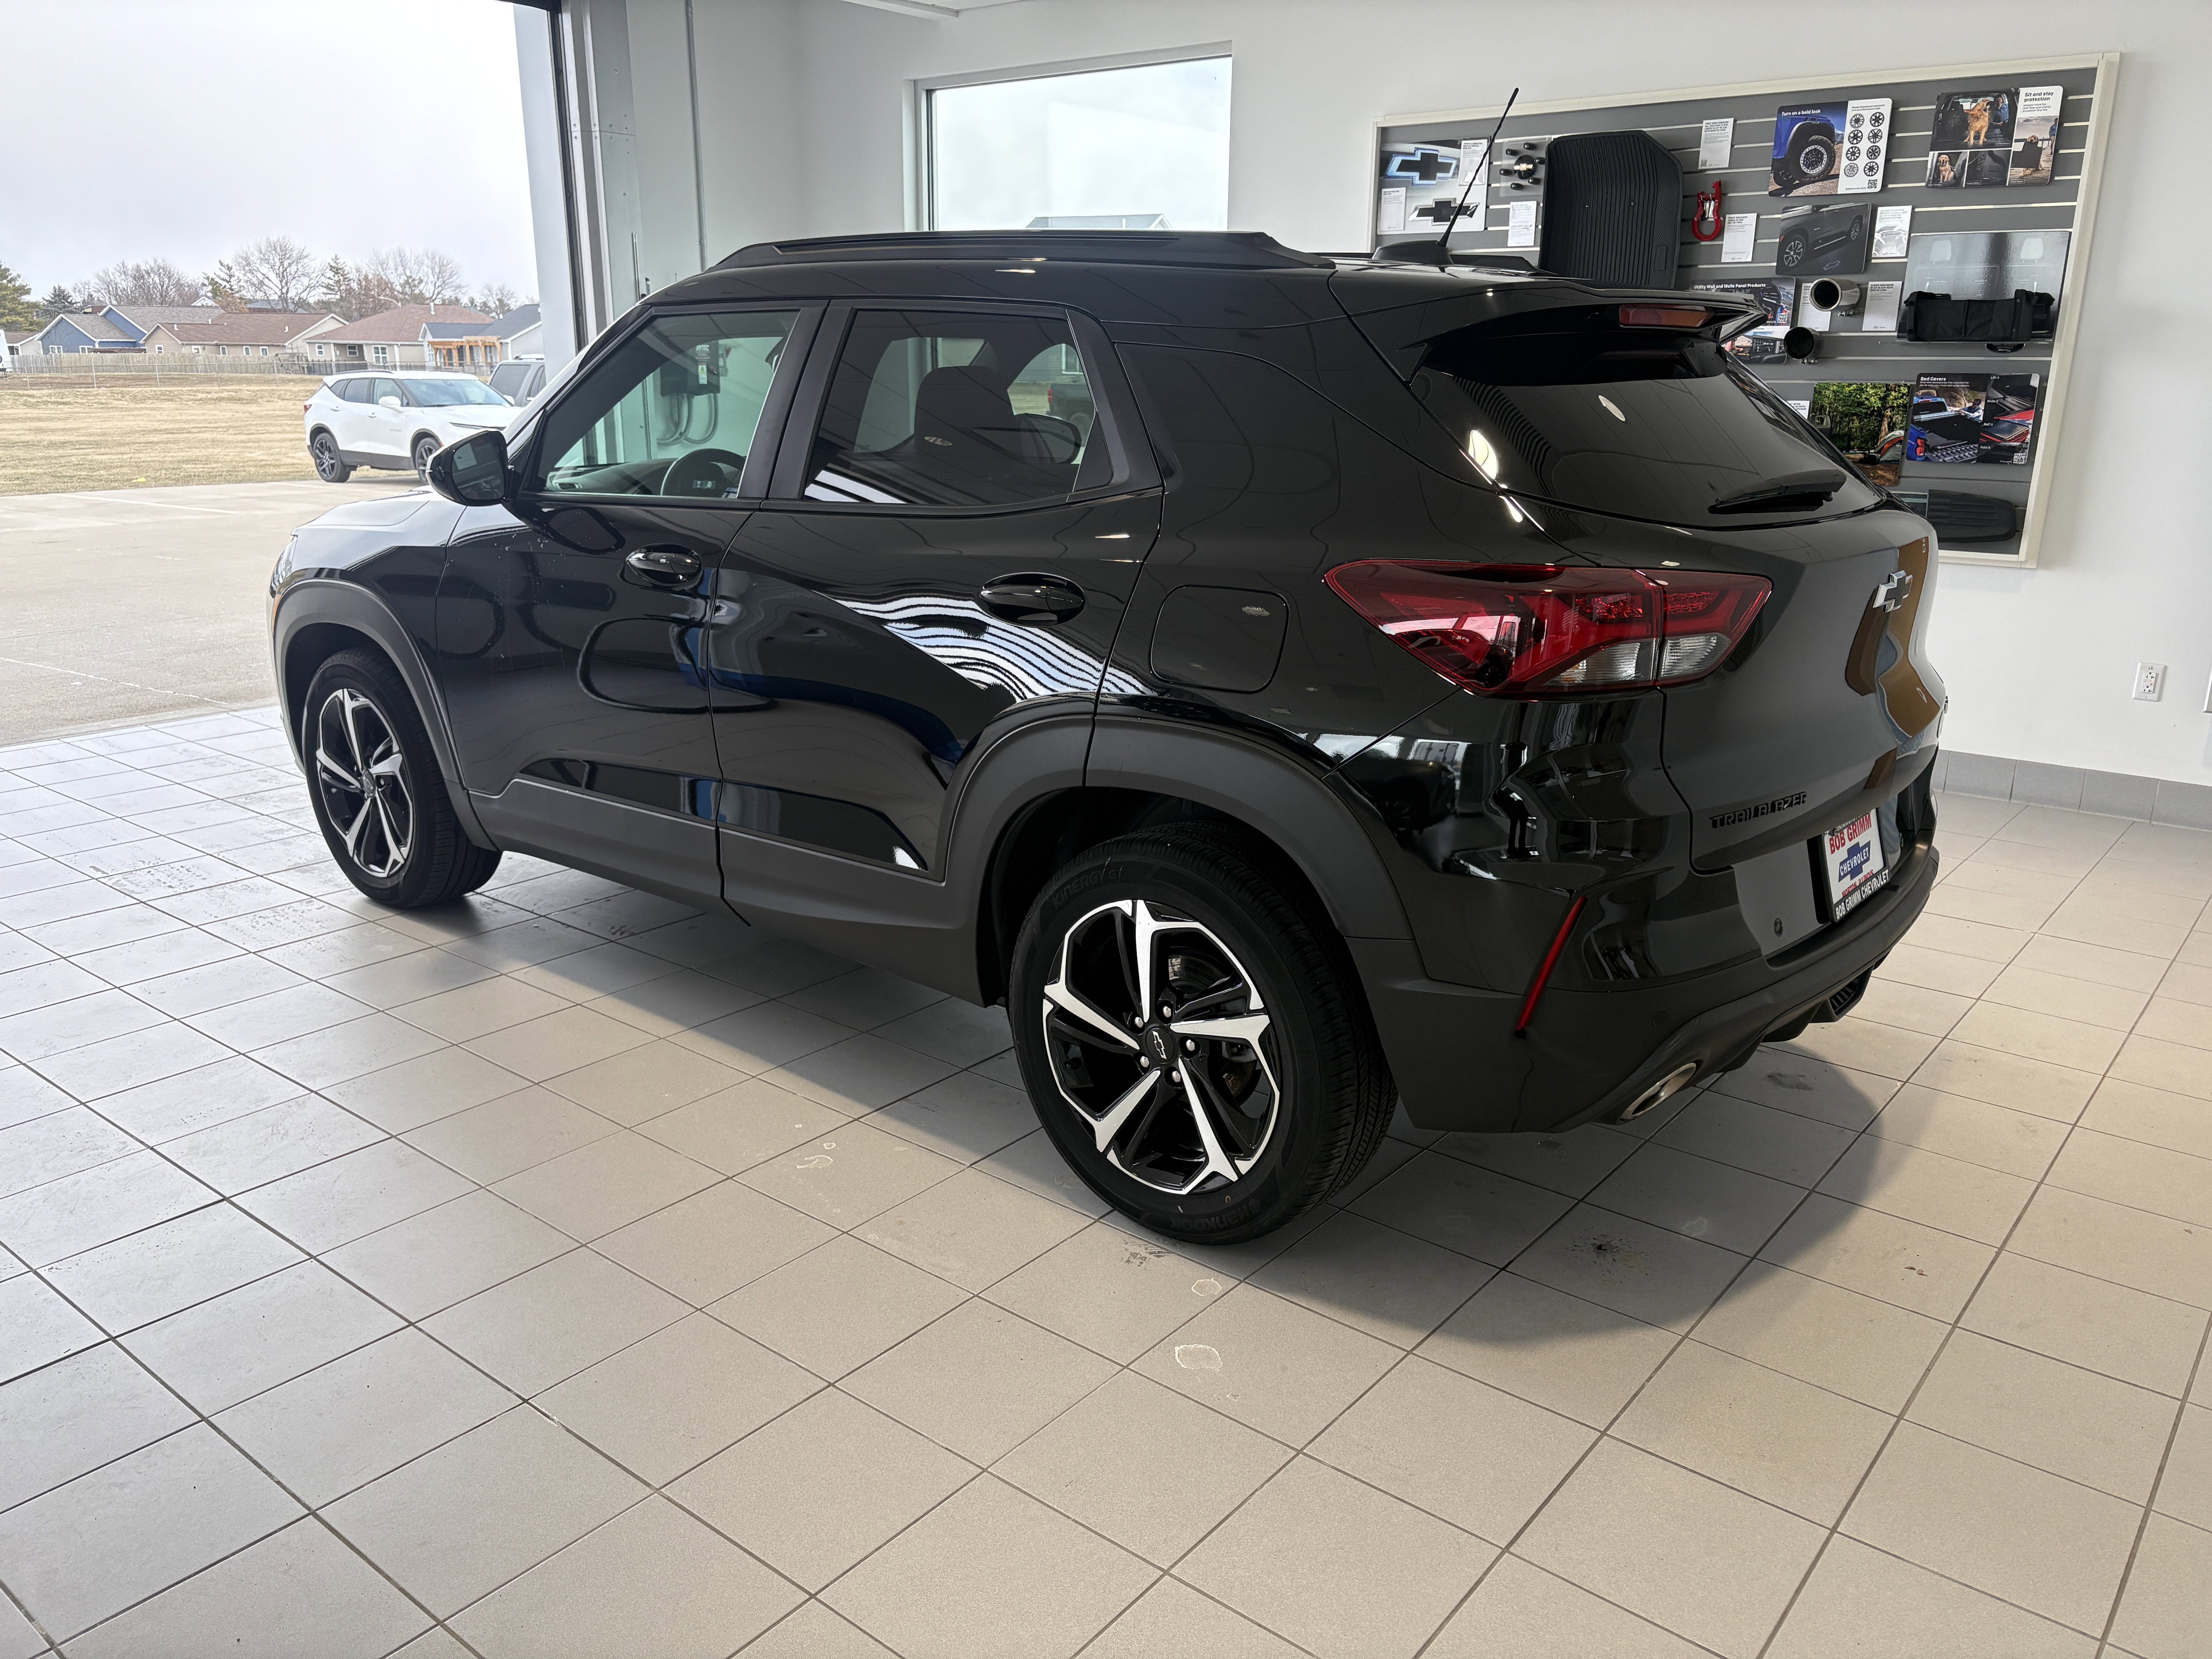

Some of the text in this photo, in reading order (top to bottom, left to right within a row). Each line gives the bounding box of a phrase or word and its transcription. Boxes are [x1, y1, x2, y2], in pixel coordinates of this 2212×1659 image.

[1709, 791, 1807, 829] TRAILBLAZER
[1829, 830, 1846, 855] BOB
[1847, 814, 1872, 842] GRIMM
[1840, 847, 1869, 876] CHEVROLET
[1836, 869, 1889, 920] BOB GRIMM CHEVROLET
